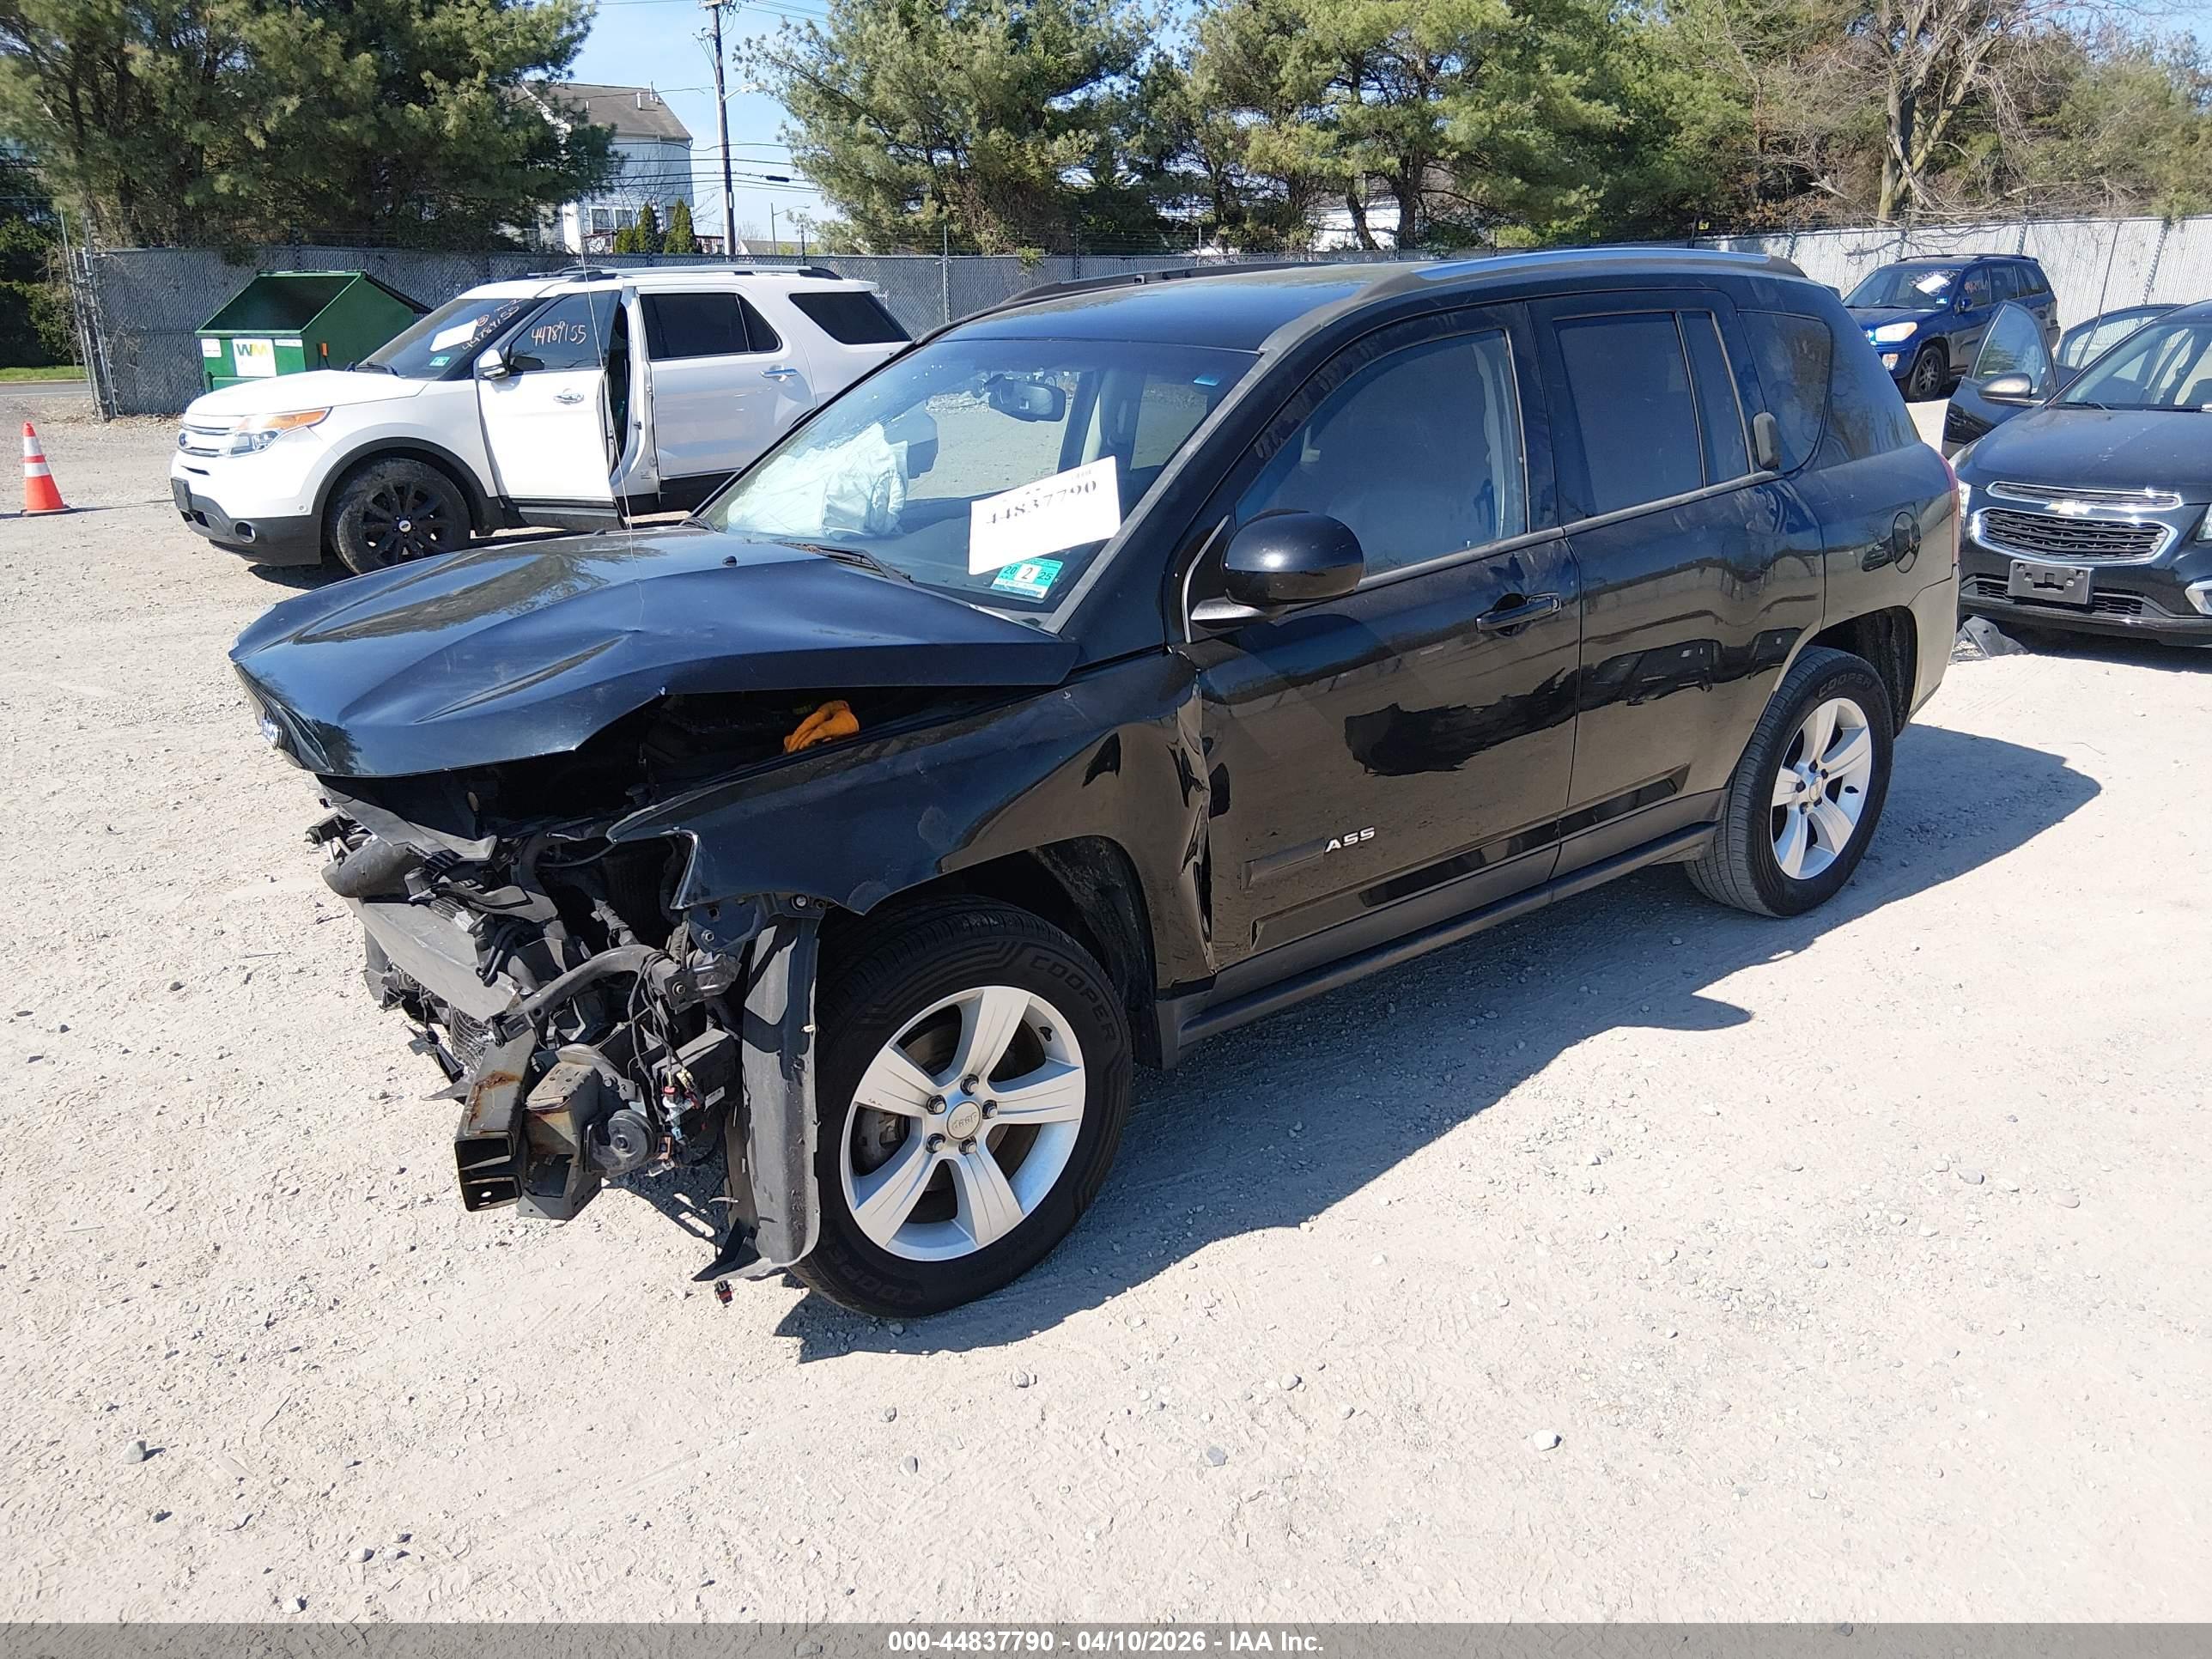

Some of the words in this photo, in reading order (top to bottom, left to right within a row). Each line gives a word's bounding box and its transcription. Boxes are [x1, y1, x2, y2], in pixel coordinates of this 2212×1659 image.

[531, 320, 587, 347] 44789155
[235, 343, 268, 356] WM
[1003, 566, 1018, 575] 20
[1021, 567, 1034, 580] 2
[1036, 571, 1054, 581] 25
[1324, 827, 1376, 854] ASS
[1030, 954, 1116, 1044] COOPER
